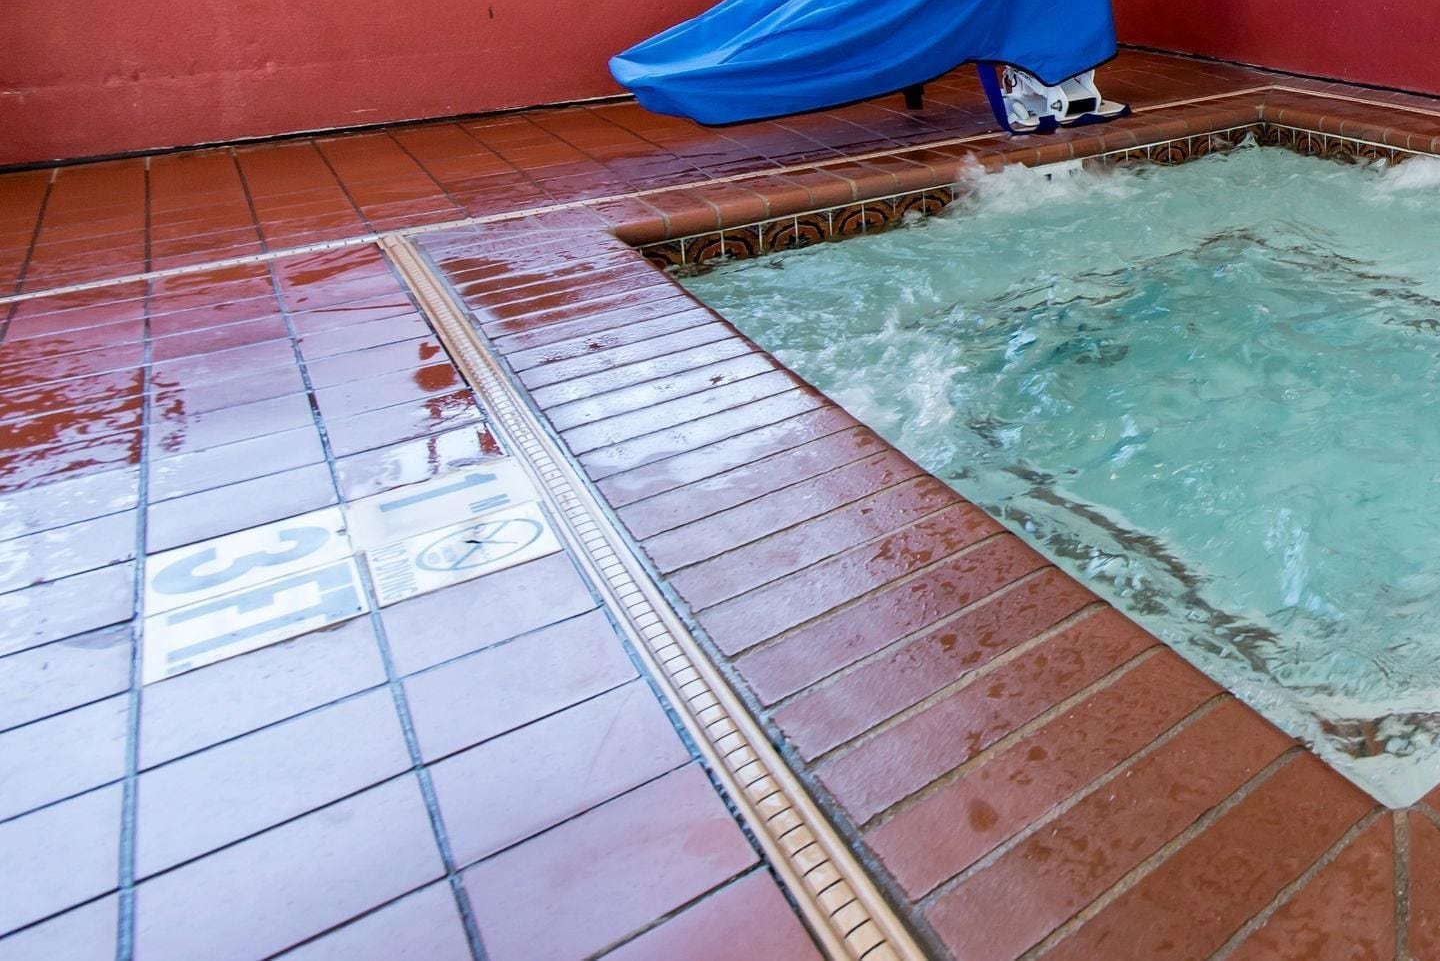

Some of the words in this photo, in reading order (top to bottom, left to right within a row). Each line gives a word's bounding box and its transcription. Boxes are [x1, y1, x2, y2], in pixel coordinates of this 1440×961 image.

[379, 473, 496, 512] 1
[152, 526, 330, 595] 3
[376, 558, 418, 601] DIVING
